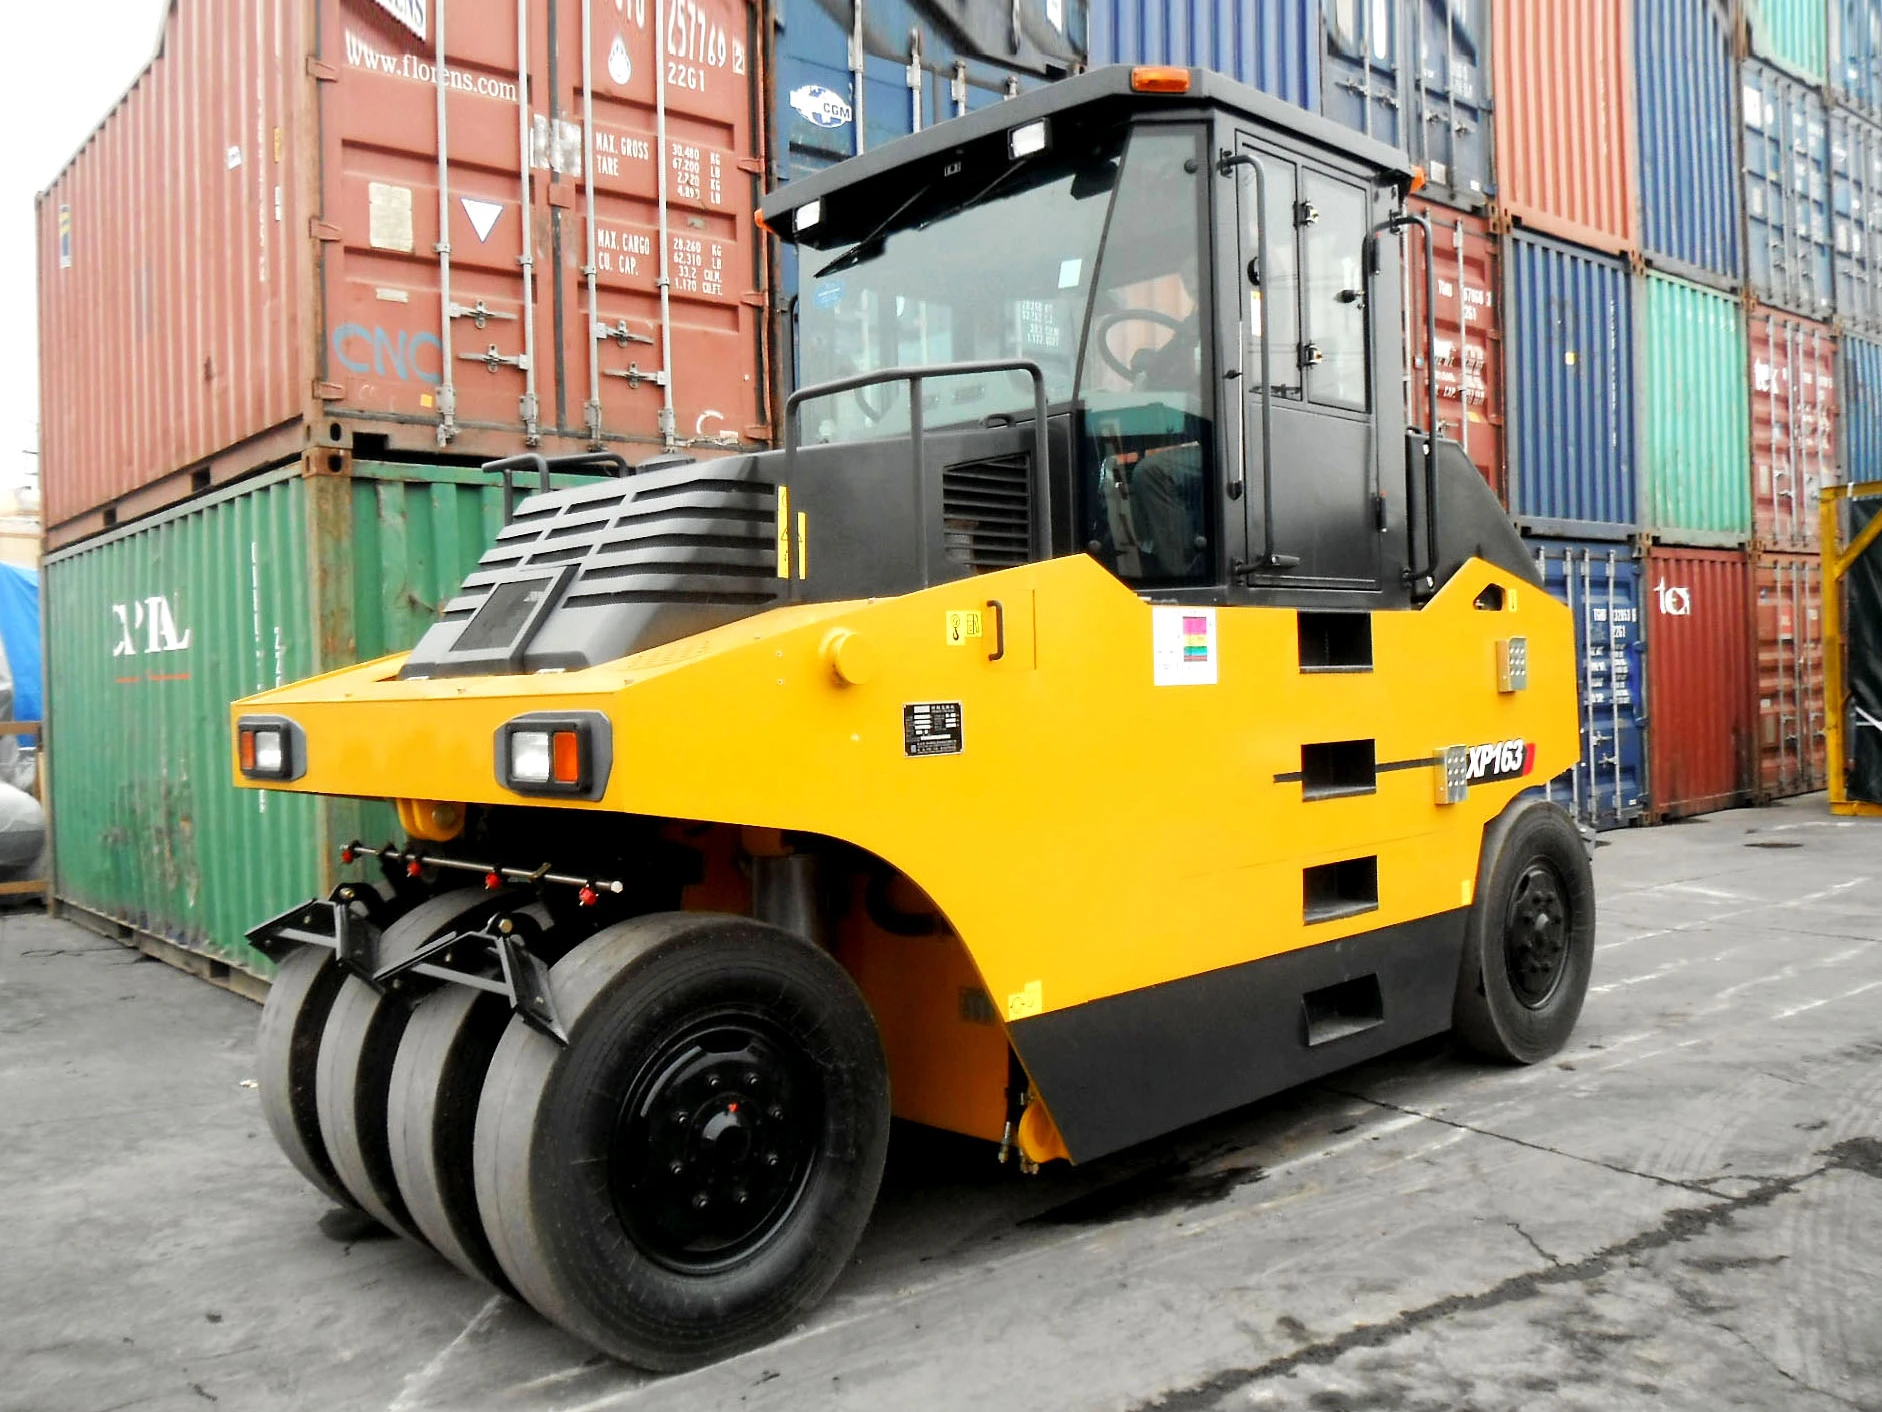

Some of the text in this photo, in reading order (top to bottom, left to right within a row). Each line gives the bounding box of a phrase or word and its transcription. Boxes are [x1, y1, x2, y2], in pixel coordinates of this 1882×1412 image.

[345, 27, 518, 101] www.florens.com
[667, 61, 705, 92] 22G1
[823, 102, 850, 119] CGM
[620, 137, 649, 160] GROSS
[672, 143, 700, 161] 30.480
[597, 155, 619, 177] TARE
[598, 228, 650, 255] MAX. CARGO
[598, 252, 638, 276] CU. CAP.
[679, 265, 697, 279] 33.2
[1465, 738, 1524, 780] XP163
